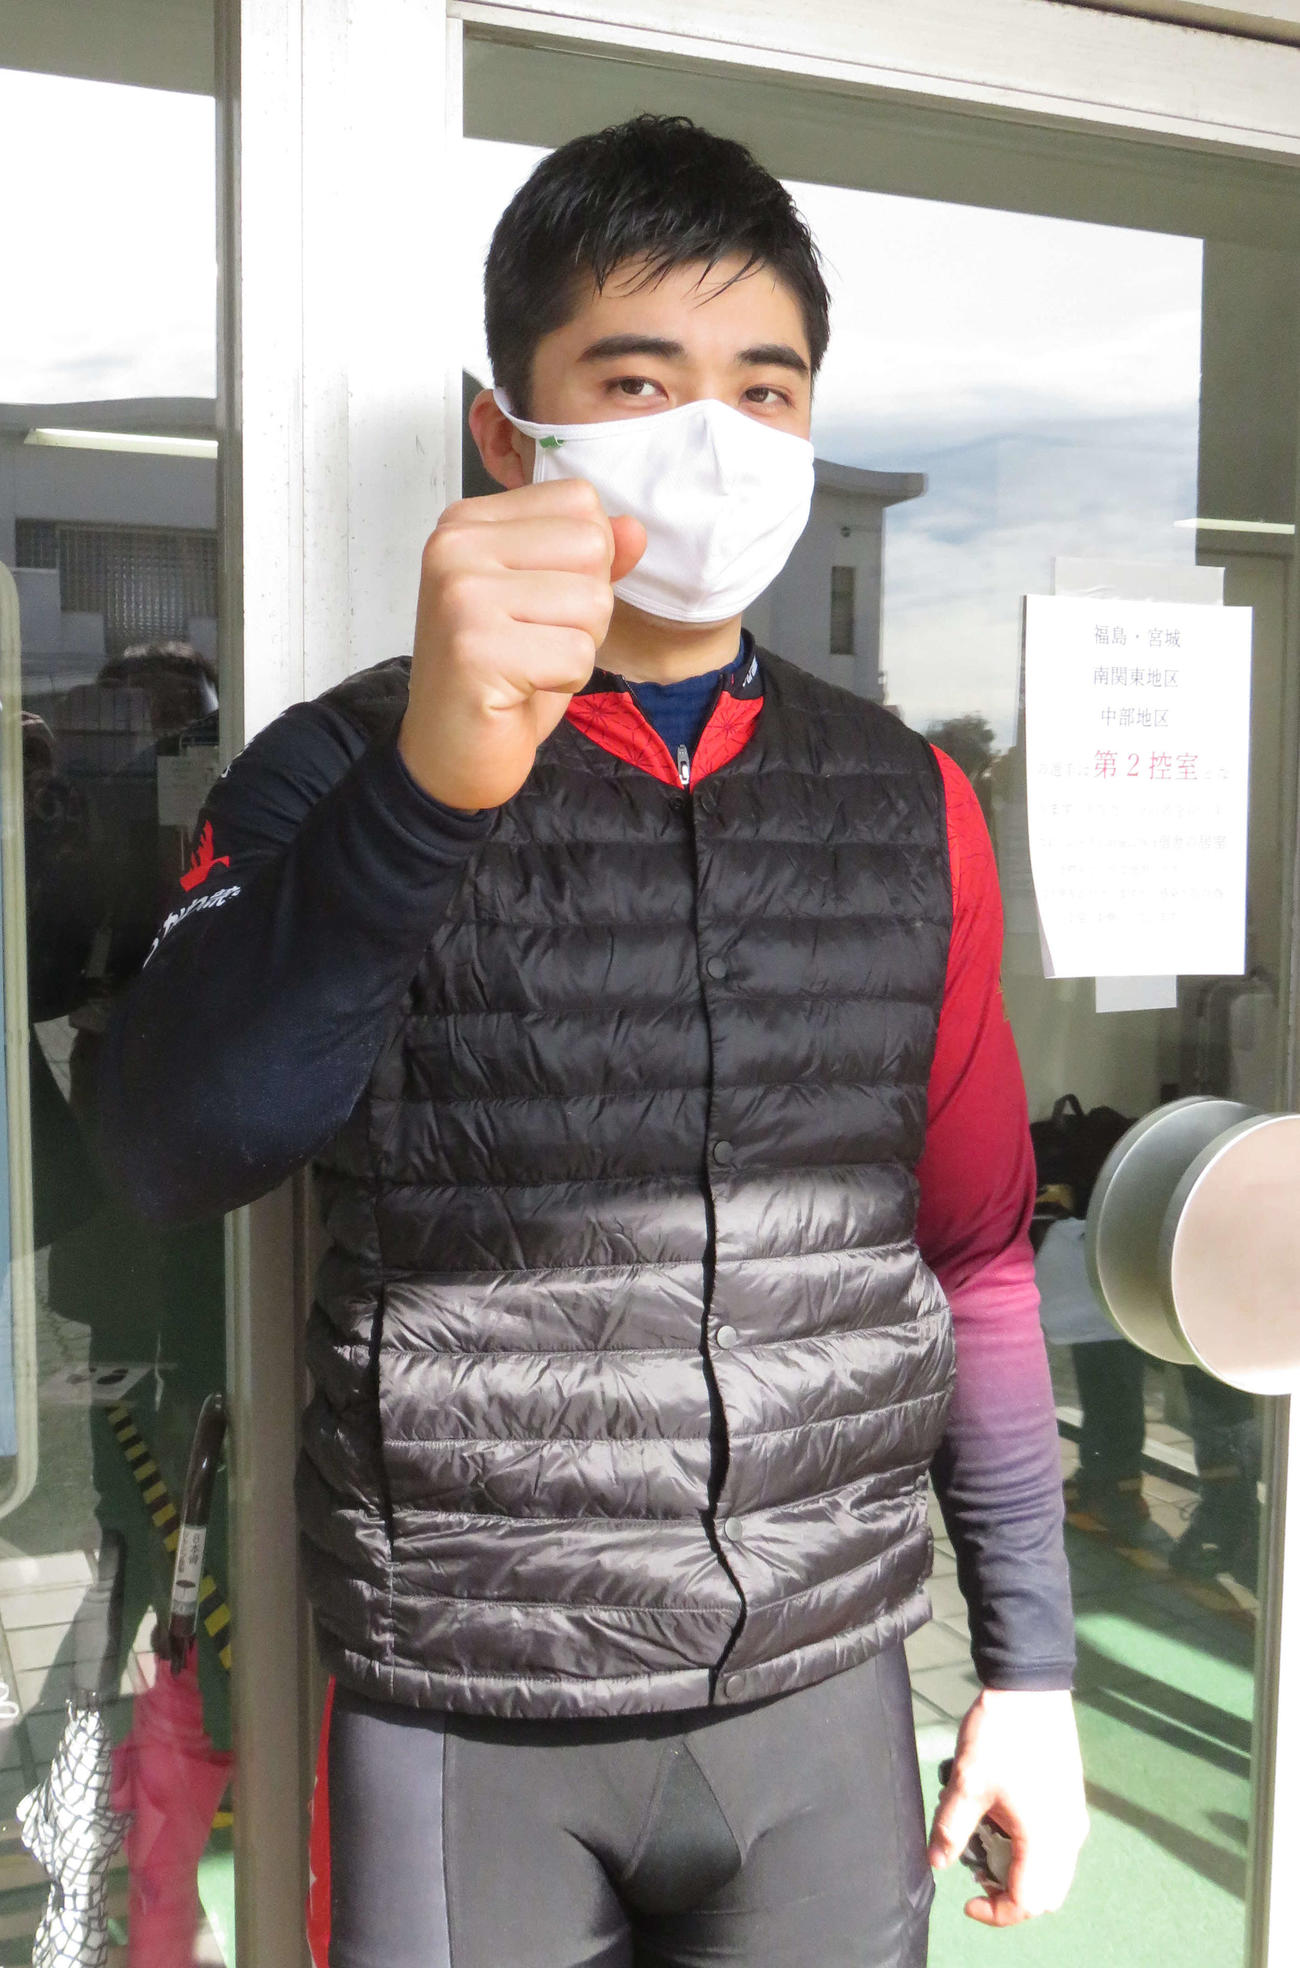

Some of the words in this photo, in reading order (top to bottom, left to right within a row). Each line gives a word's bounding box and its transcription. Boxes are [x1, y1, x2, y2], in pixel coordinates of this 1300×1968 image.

[1094, 624, 1181, 648] 福島・宮城
[1093, 666, 1179, 688] 南関東地区
[1100, 706, 1169, 728] 中部地区
[1094, 749, 1199, 781] 第2控室
